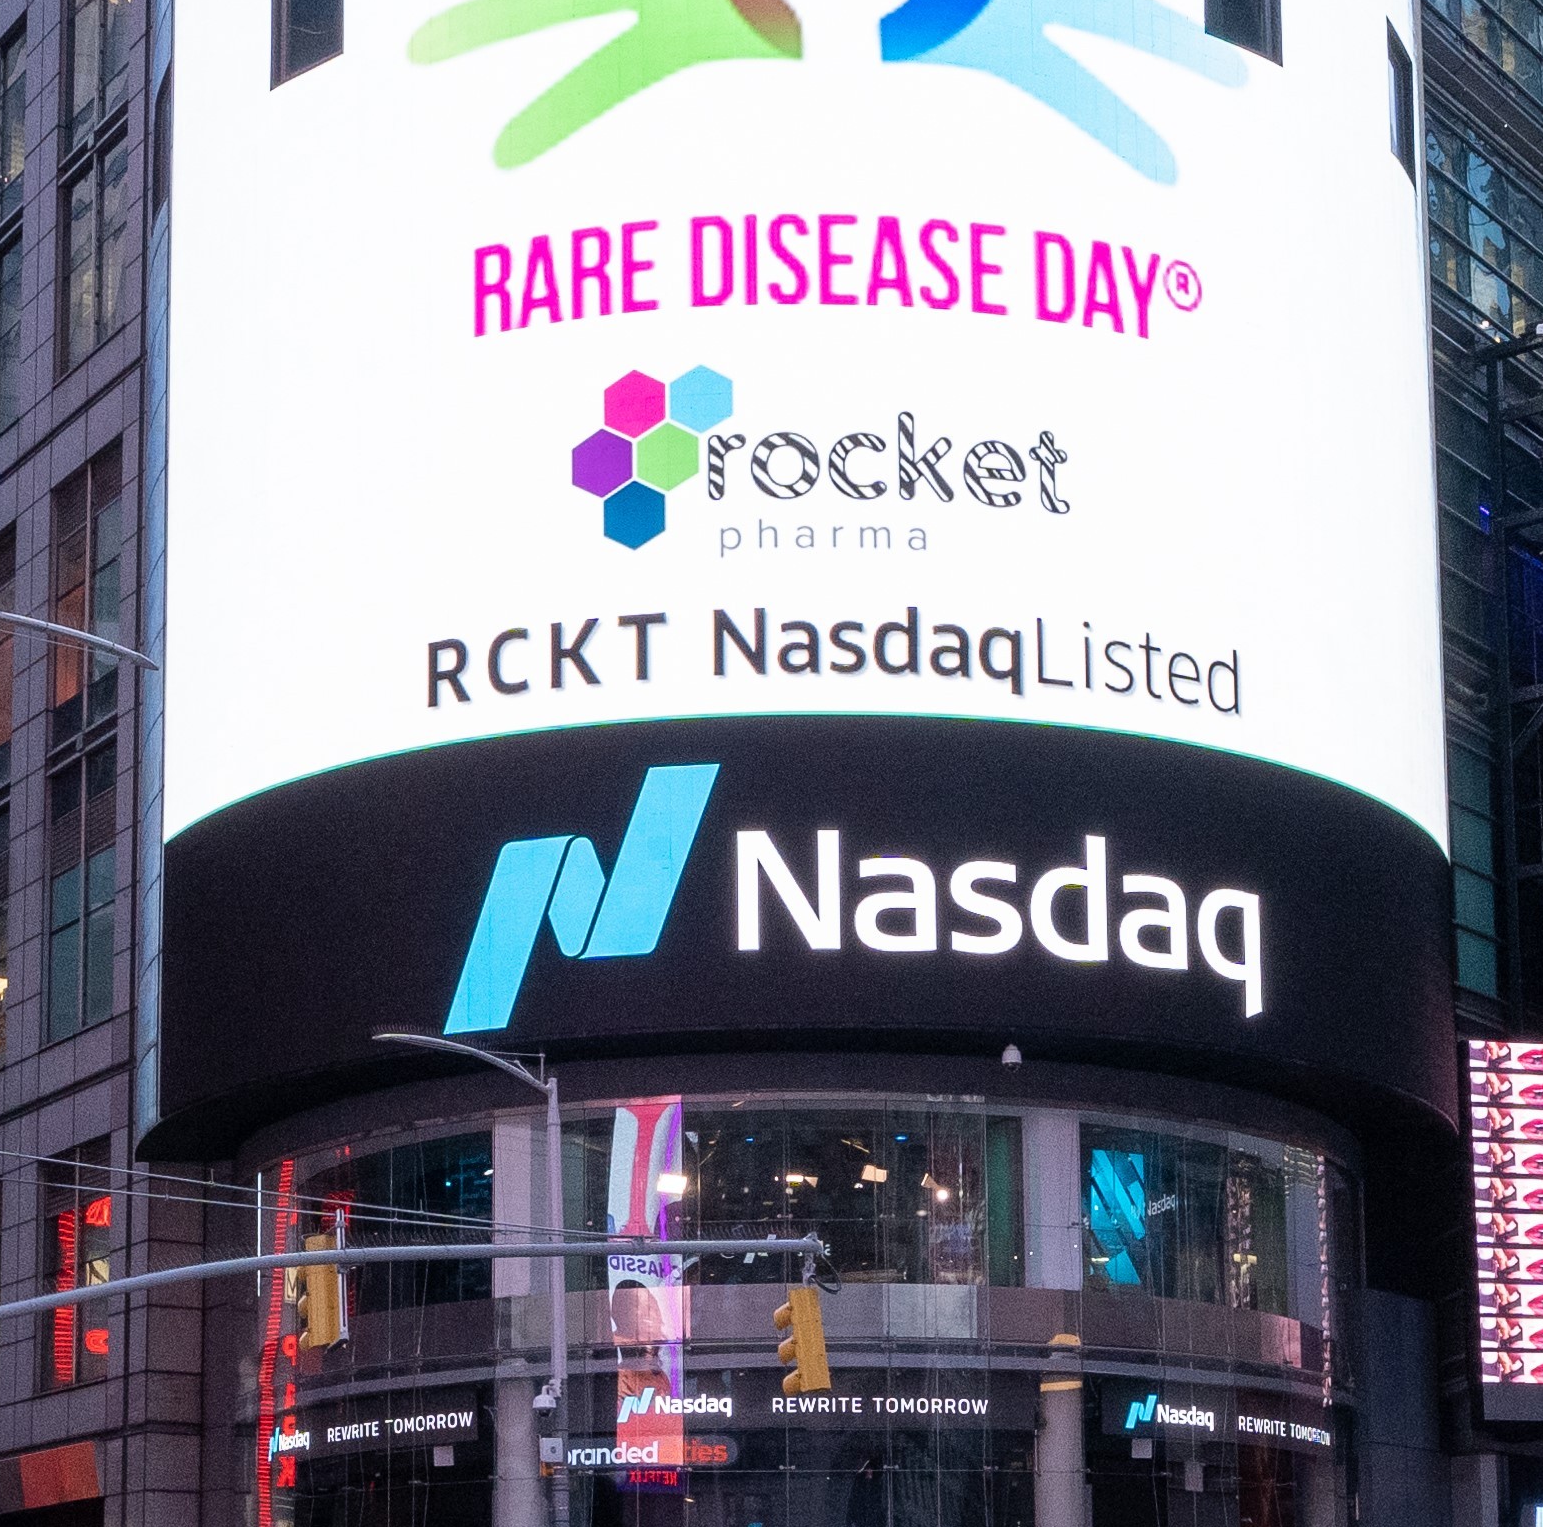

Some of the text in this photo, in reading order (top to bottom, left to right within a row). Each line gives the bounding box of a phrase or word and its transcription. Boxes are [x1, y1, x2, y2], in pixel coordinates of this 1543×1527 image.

[473, 220, 660, 338] RARE
[689, 213, 1007, 316] DISEASE
[705, 411, 1071, 514] rocket
[719, 517, 929, 557] pharma
[426, 613, 667, 707] RCKT
[734, 827, 1263, 1019] Nasdaq
[278, 1411, 473, 1452] Nasdaq REWRITE TOMORROW
[655, 1394, 989, 1417] Nasdaq REWRITE TOMORROW
[1157, 1402, 1214, 1431] Nasdaq
[1238, 1415, 1286, 1436] REWRITE
